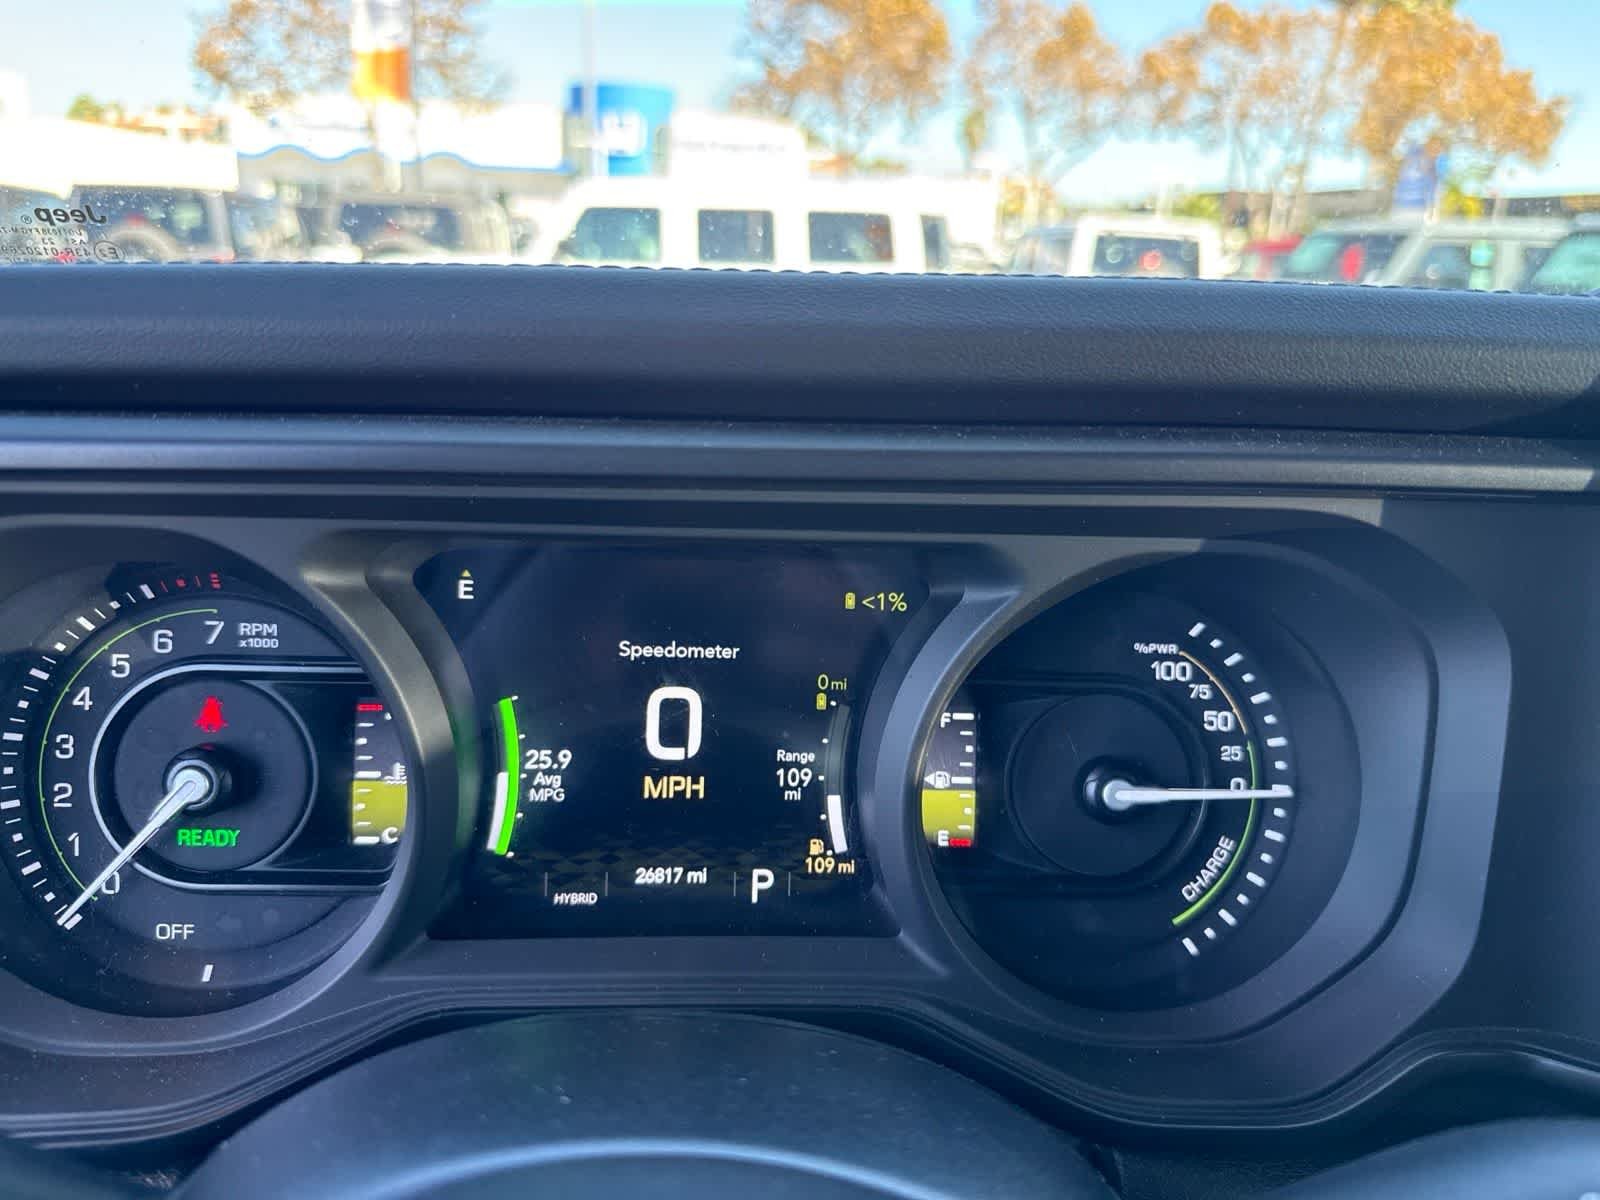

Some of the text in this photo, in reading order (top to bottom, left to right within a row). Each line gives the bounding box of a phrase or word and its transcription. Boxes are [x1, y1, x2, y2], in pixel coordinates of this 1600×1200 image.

[458, 579, 474, 600] E
[861, 593, 908, 612] <1%
[204, 620, 224, 644] 7
[238, 622, 278, 637] RPM
[152, 630, 173, 654] 6
[239, 637, 279, 649] x1000
[618, 640, 740, 661] Speedometer
[1134, 643, 1178, 654] %PWR
[110, 653, 131, 678] 5
[1151, 661, 1192, 681] 100
[72, 686, 93, 711] 4
[1188, 684, 1213, 700] 75
[646, 686, 703, 761] 0
[940, 712, 951, 728] F
[1203, 710, 1235, 732] 50
[55, 734, 74, 759] 3
[1220, 746, 1243, 761] 25
[525, 750, 572, 770] 25.9
[776, 750, 815, 765] Range
[533, 773, 561, 790] Avg
[776, 768, 813, 787] 109
[53, 783, 73, 808] 2
[529, 788, 565, 802] MPG
[643, 775, 705, 800] MPH
[784, 787, 802, 801] mi
[67, 832, 80, 857] 1
[177, 829, 240, 848] READY
[381, 826, 399, 845] C
[938, 829, 950, 847] E
[805, 857, 855, 874] 109 mi
[1181, 835, 1236, 901] CHARGE
[101, 871, 121, 895] 0
[635, 867, 707, 884] 26817 mi
[751, 868, 774, 903] P
[553, 892, 598, 905] HYBRID
[156, 923, 195, 940] OFF
